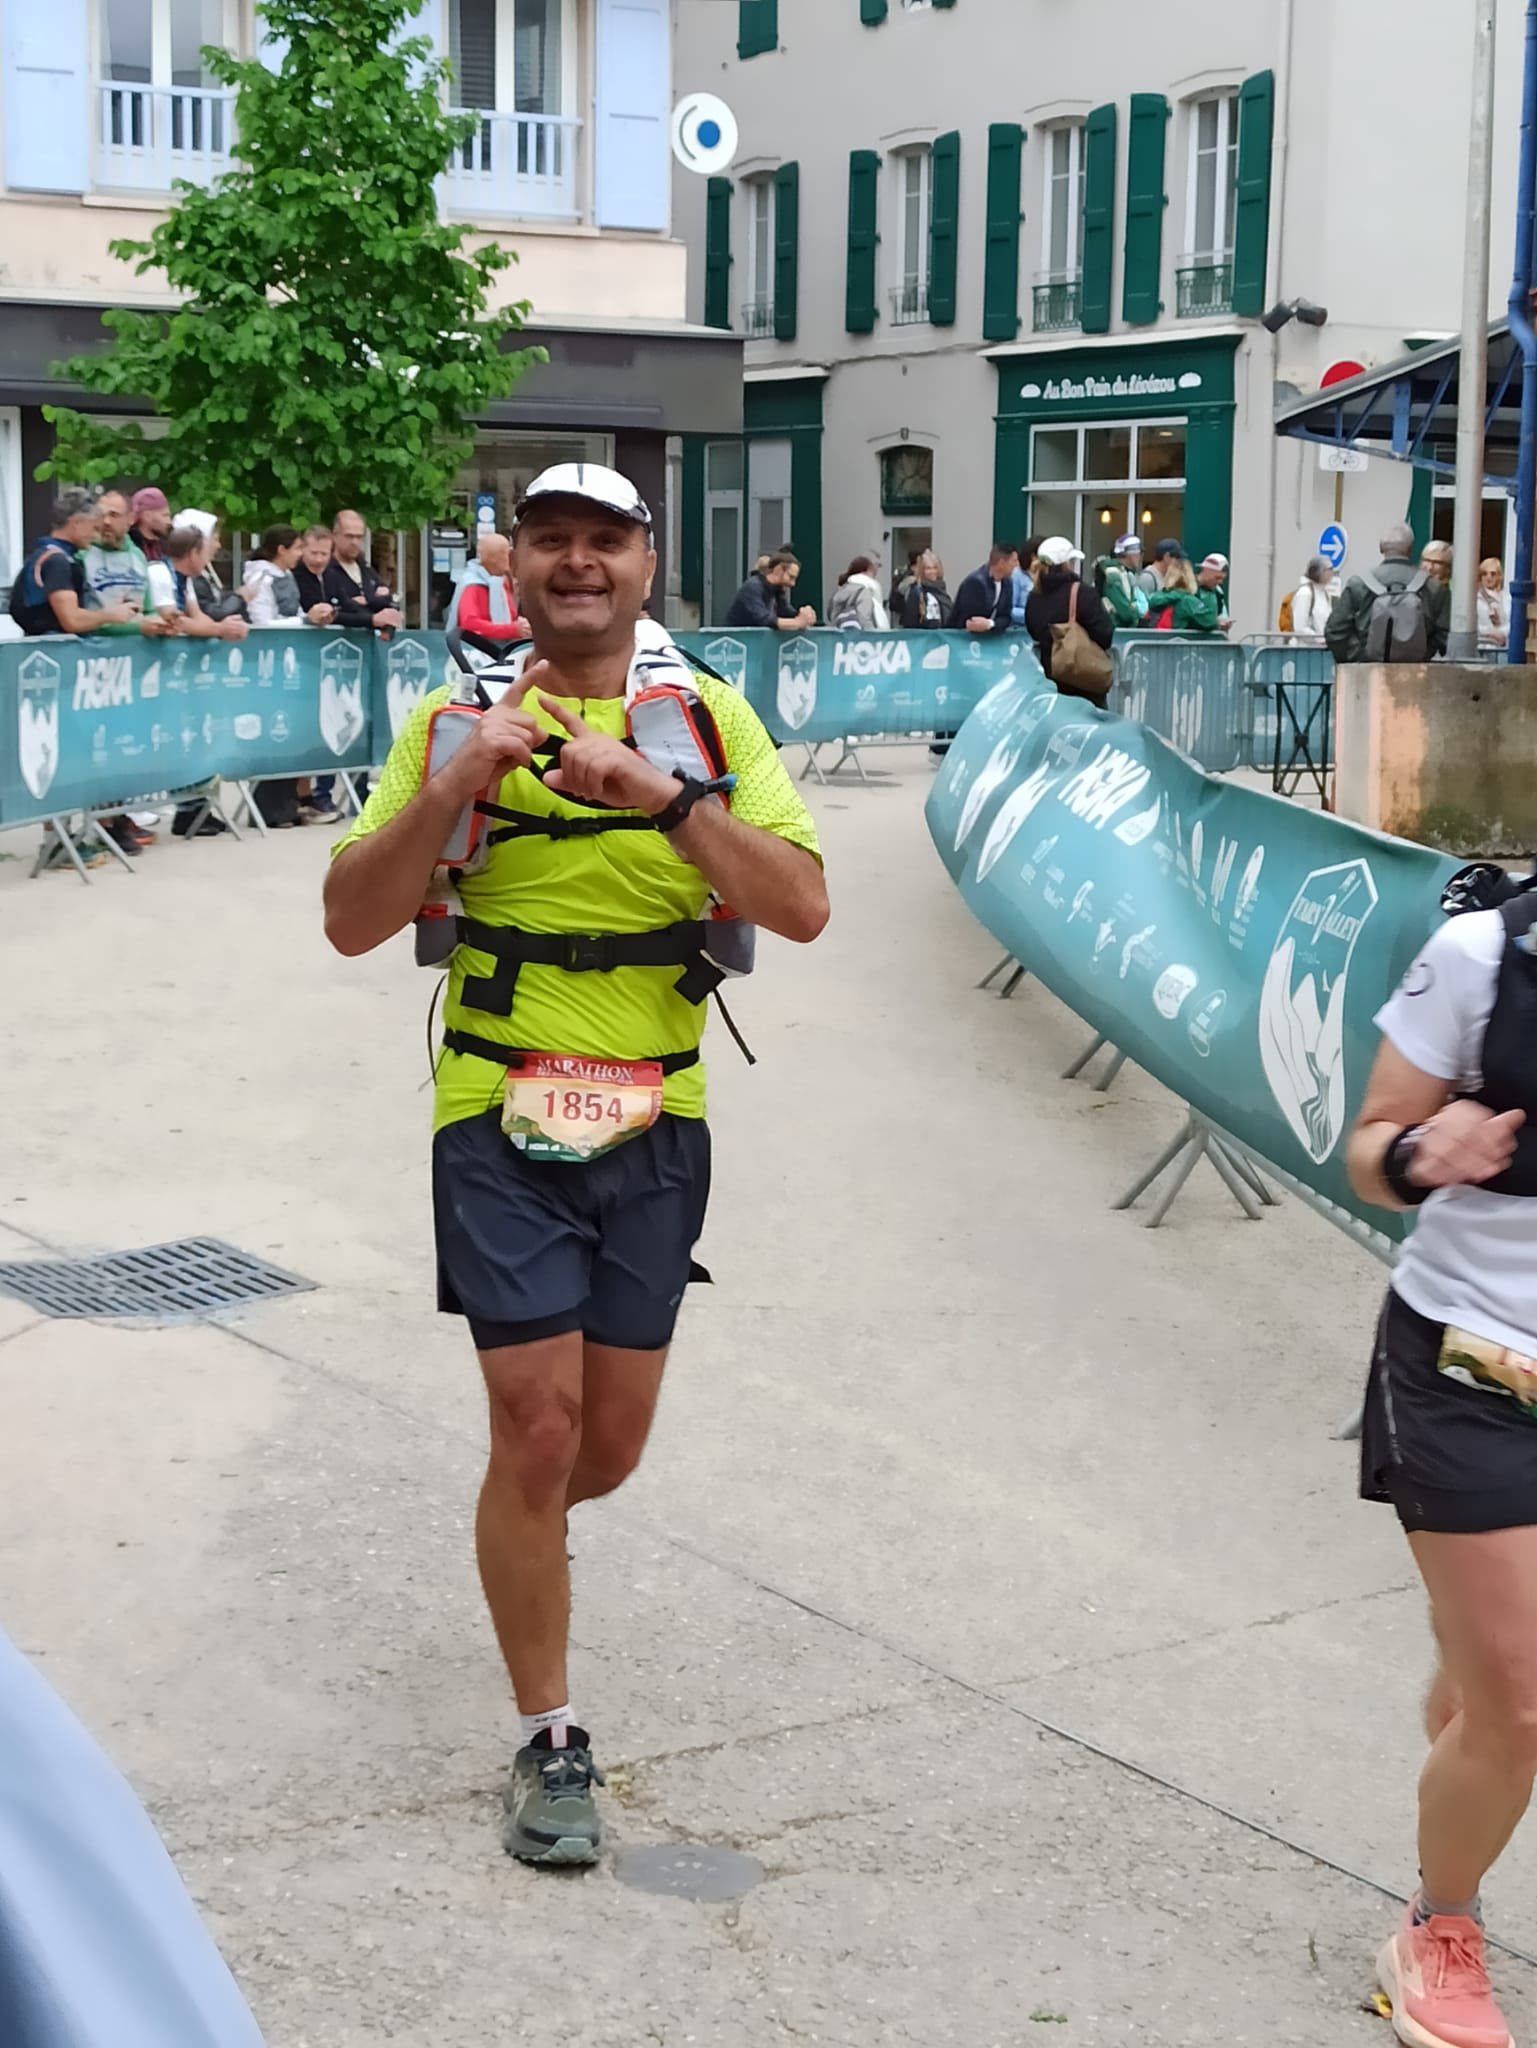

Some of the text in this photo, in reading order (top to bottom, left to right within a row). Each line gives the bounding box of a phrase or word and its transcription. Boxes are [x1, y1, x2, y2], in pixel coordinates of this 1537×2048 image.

[1042, 379, 1060, 399] Au
[1061, 378, 1085, 399] Bon
[1085, 376, 1112, 397] Pain
[1112, 374, 1128, 395] du
[832, 640, 912, 676] HOKA
[72, 655, 134, 711] HOKA
[1057, 743, 1151, 831] HOKA
[537, 1059, 635, 1081] MARATHON
[543, 1090, 623, 1123] 1854
